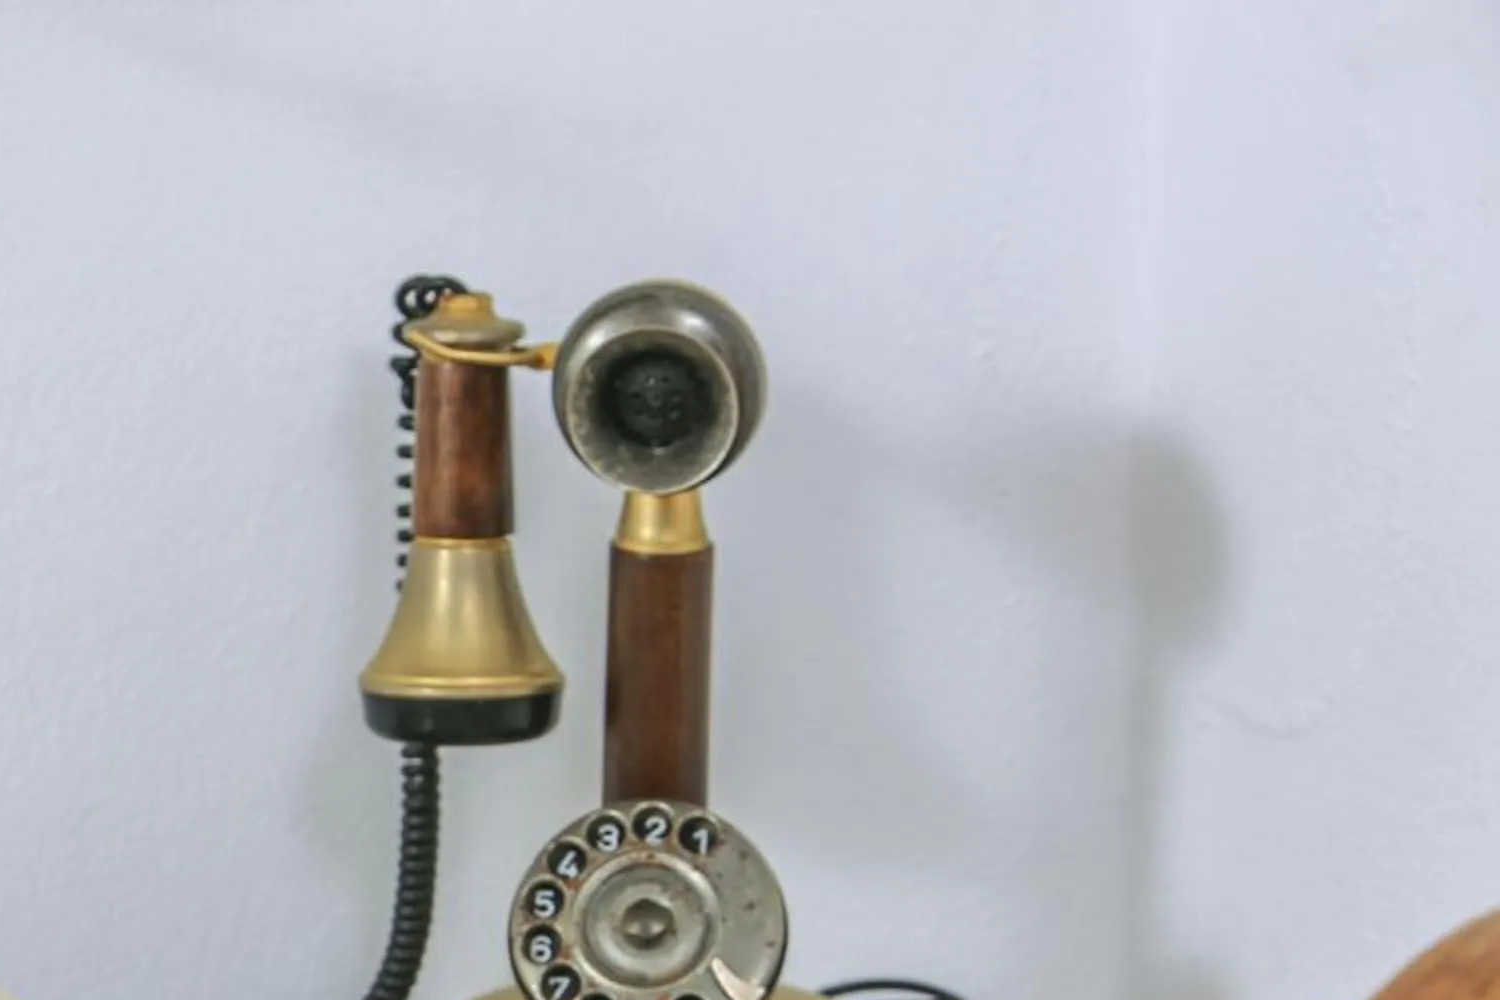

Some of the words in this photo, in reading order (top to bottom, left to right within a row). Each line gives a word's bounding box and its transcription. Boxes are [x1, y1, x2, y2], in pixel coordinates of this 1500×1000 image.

[597, 823, 620, 851] 3
[644, 816, 668, 844] 2
[693, 829, 709, 854] 1
[556, 851, 578, 877] 4
[533, 890, 556, 917] 5
[529, 936, 553, 963] 6
